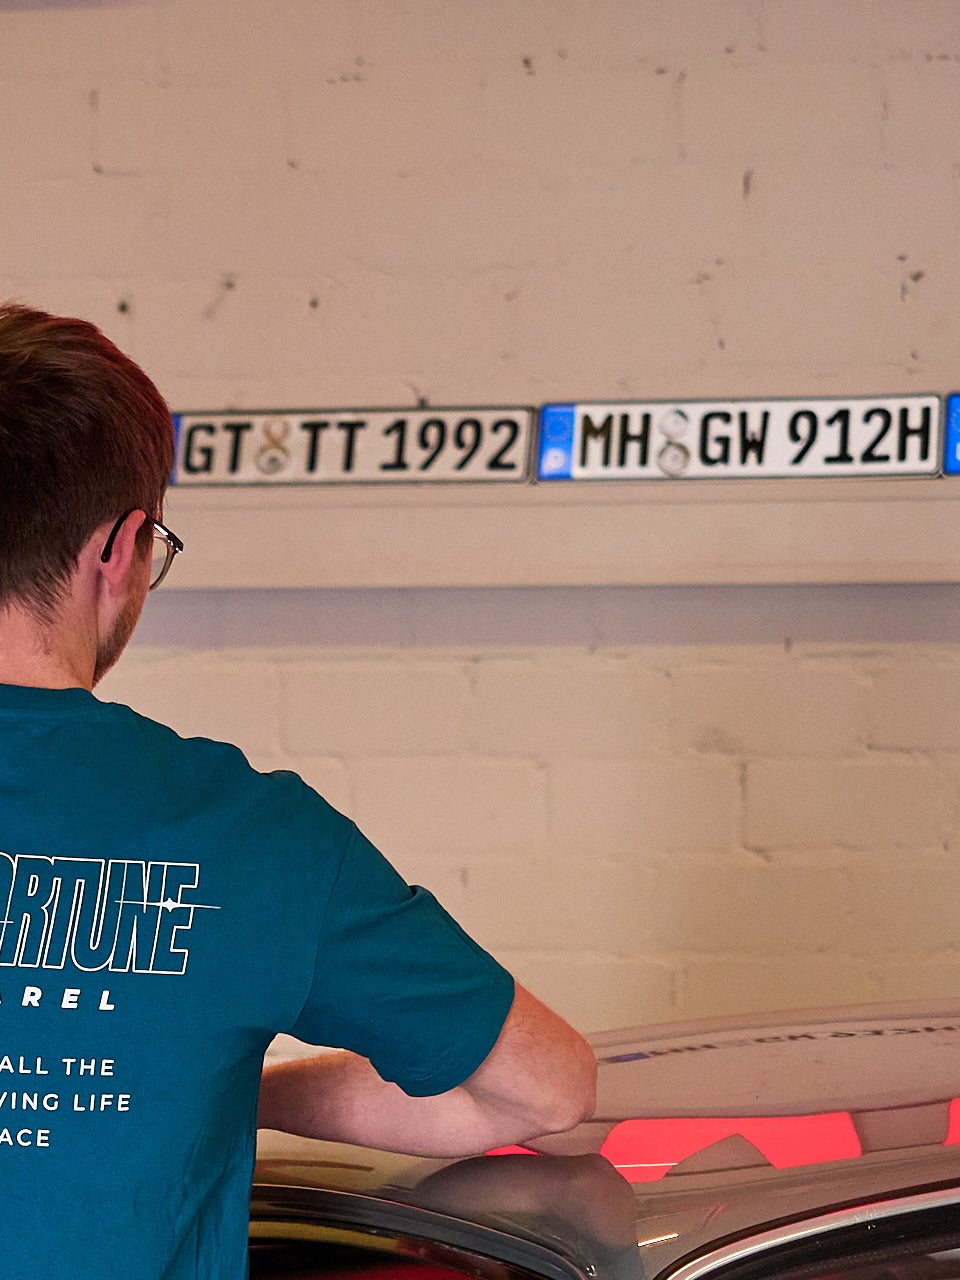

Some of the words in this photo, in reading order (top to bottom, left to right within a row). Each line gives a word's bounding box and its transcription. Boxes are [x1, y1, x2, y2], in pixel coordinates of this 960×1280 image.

[182, 422, 253, 474] GT
[300, 420, 367, 473] TT
[379, 418, 520, 471] 1992
[579, 413, 651, 467] MH
[698, 411, 769, 466] GW
[788, 406, 932, 464] 912H
[61, 1058, 115, 1077] THE
[73, 1093, 131, 1112] LIFE
